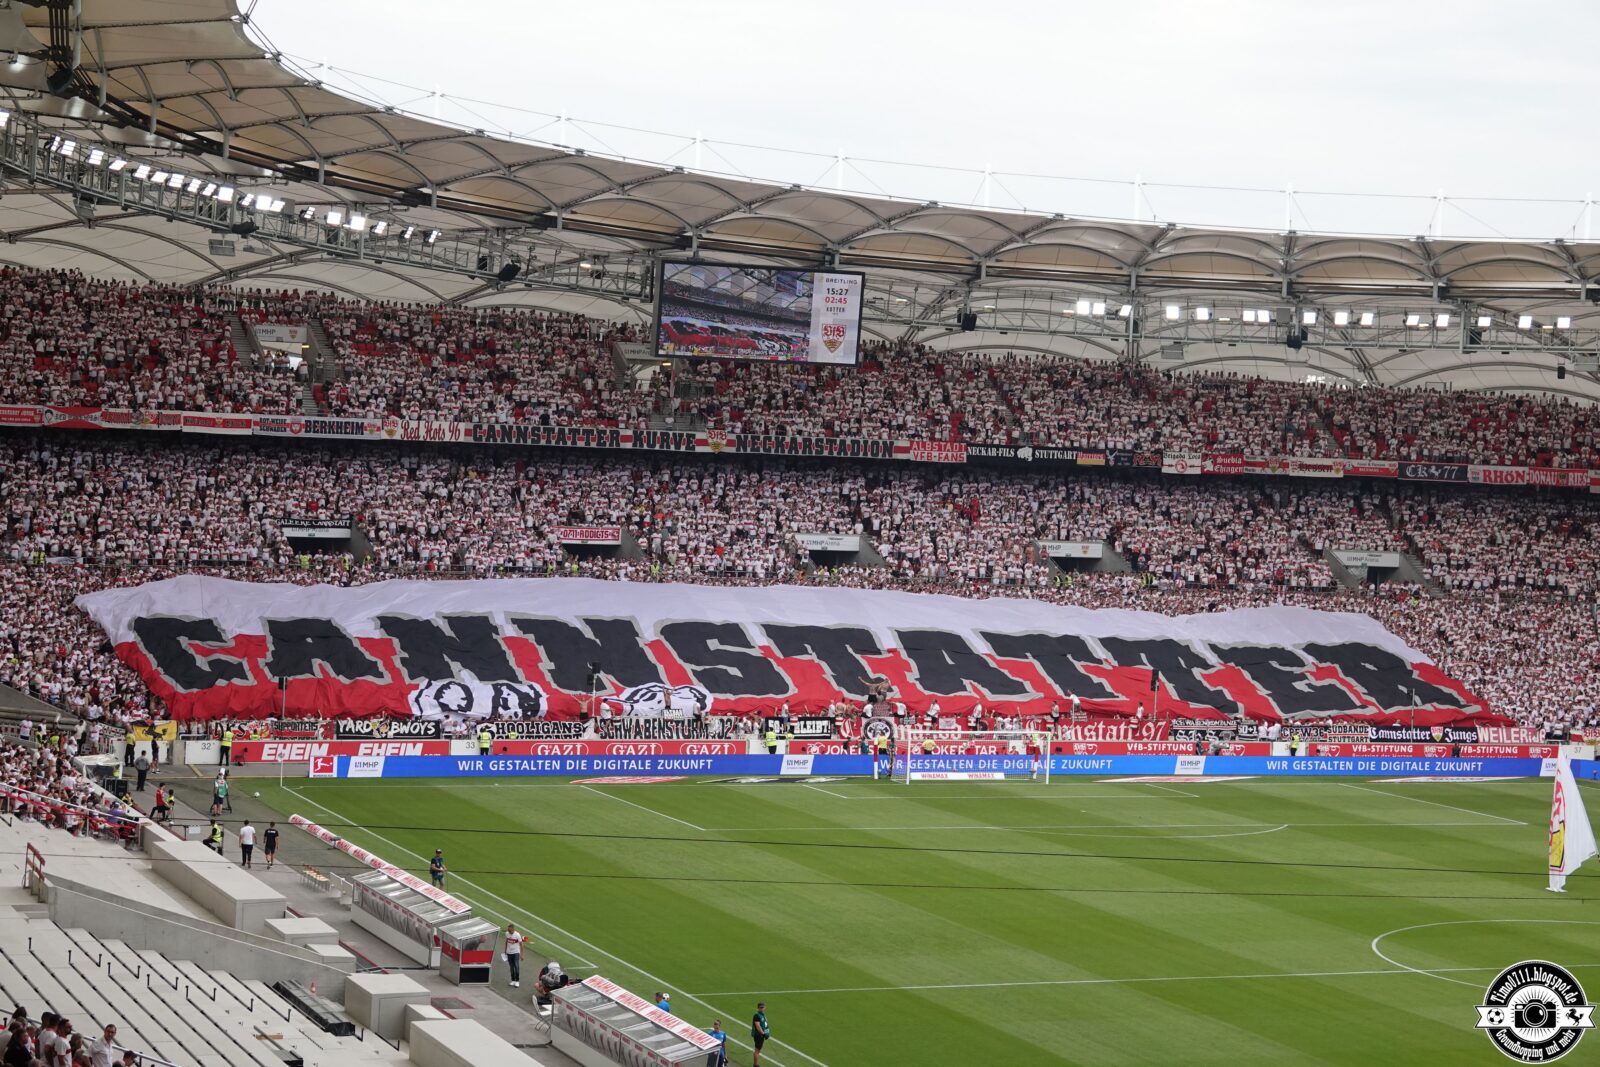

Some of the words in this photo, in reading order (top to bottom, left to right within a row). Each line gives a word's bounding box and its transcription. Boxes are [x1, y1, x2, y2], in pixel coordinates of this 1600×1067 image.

[826, 278, 858, 286] BREITLING
[826, 287, 849, 296] 15:27
[824, 296, 848, 305] 02:45
[304, 419, 365, 435] BERKHEIM
[400, 420, 420, 440] Red
[422, 420, 446, 441] Hots
[448, 421, 460, 441] 96
[472, 424, 621, 448] CANNSTATTER
[631, 430, 696, 452] KURVE
[735, 434, 895, 458] NECKARSTADION
[911, 442, 967, 453] ALBSTADT
[913, 451, 966, 463] VFB-FANS
[967, 446, 1015, 458] NECKAR-FILS
[1034, 449, 1077, 460] STUTTGART
[1442, 465, 1459, 480] 77
[1529, 469, 1557, 486] DONAU
[1568, 471, 1588, 486] RIES
[563, 529, 578, 539] 0711
[579, 530, 609, 540] ADDICTS
[129, 611, 1485, 720] CANNSTATTER
[337, 719, 373, 735] YARD
[495, 722, 583, 735] HOOLIGANS
[1141, 722, 1167, 743] 97
[1312, 727, 1325, 738] 36
[1328, 736, 1369, 745] STUTTGART
[1370, 727, 1431, 742] Cannstatter
[1444, 728, 1478, 744] Jungs
[261, 743, 330, 761] EHEIM
[358, 743, 424, 756] EHEIM
[465, 742, 476, 750] 33
[1127, 743, 1194, 752] VfB-STIFTUNG
[1351, 745, 1414, 754] VfB-STIFTUNG
[457, 760, 483, 771] WIR
[489, 760, 561, 772] GESTALTEN
[566, 760, 588, 771] DIE
[593, 760, 652, 771] DIGITALE
[657, 759, 713, 771] ZUKUNFT
[880, 760, 903, 770] WR
[909, 760, 974, 770] GESTALTEN
[978, 760, 998, 770] DIE
[1061, 760, 1113, 770] ZUKUNFT
[1266, 761, 1288, 771] WIR
[1292, 761, 1353, 771] GESTALTEN
[1358, 761, 1376, 771] DIE
[1381, 761, 1431, 772] DIGITALE
[1434, 762, 1483, 773] ZUKUNFT
